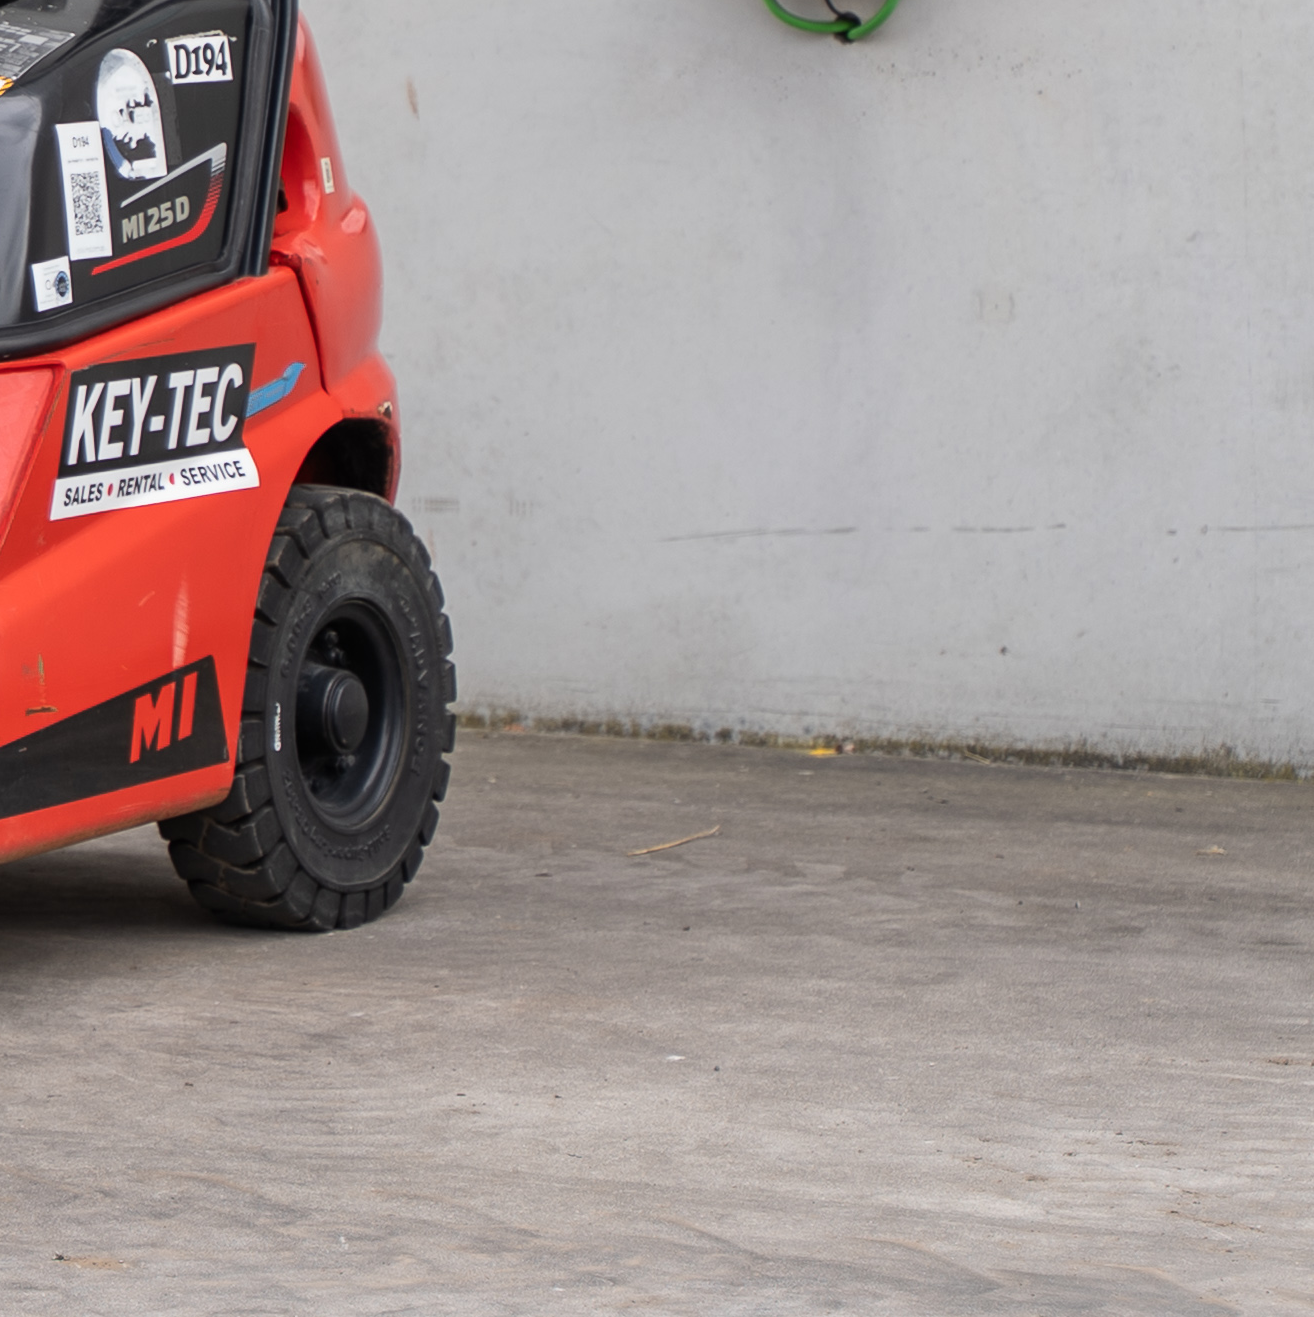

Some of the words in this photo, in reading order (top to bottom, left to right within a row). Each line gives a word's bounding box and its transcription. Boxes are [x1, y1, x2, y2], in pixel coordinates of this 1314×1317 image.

[174, 41, 227, 80] D194
[67, 363, 243, 466] KEY-TEC
[63, 483, 104, 507] SALES
[117, 473, 165, 498] RENTAL
[180, 460, 246, 486] SERVICE
[129, 671, 198, 764] MI
